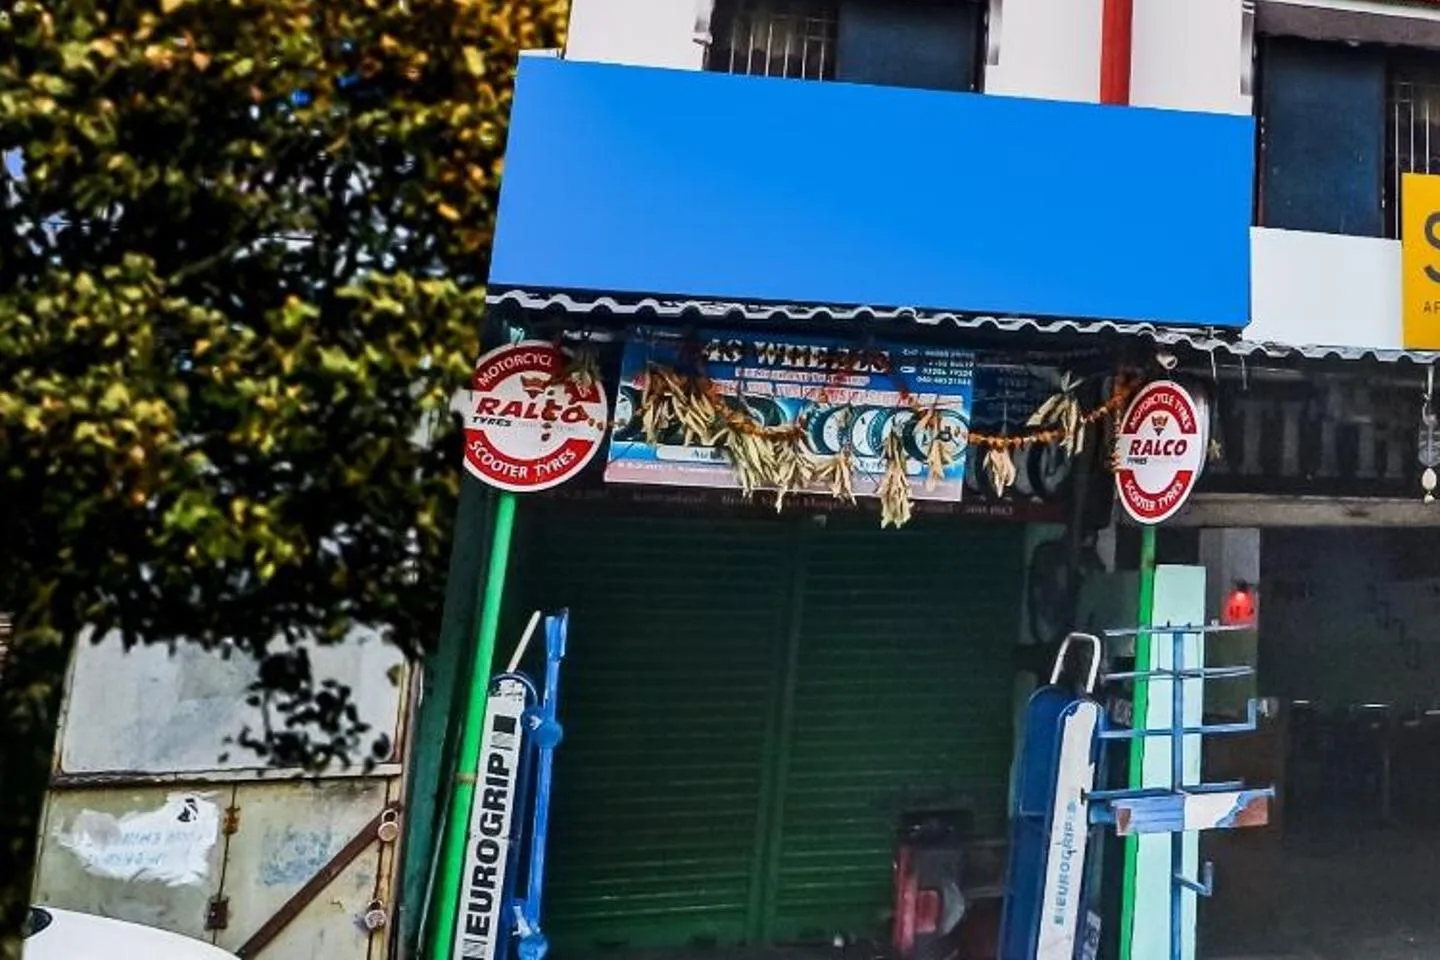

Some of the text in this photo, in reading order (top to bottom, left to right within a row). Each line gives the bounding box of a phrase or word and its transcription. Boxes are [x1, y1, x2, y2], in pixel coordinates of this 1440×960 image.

[476, 397, 589, 423] RALCO
[469, 440, 577, 479] SCOOTER TYRES
[1128, 438, 1188, 457] RALCO
[466, 752, 511, 937] EUROGRIP
[1057, 821, 1076, 907] EUROGRIP
